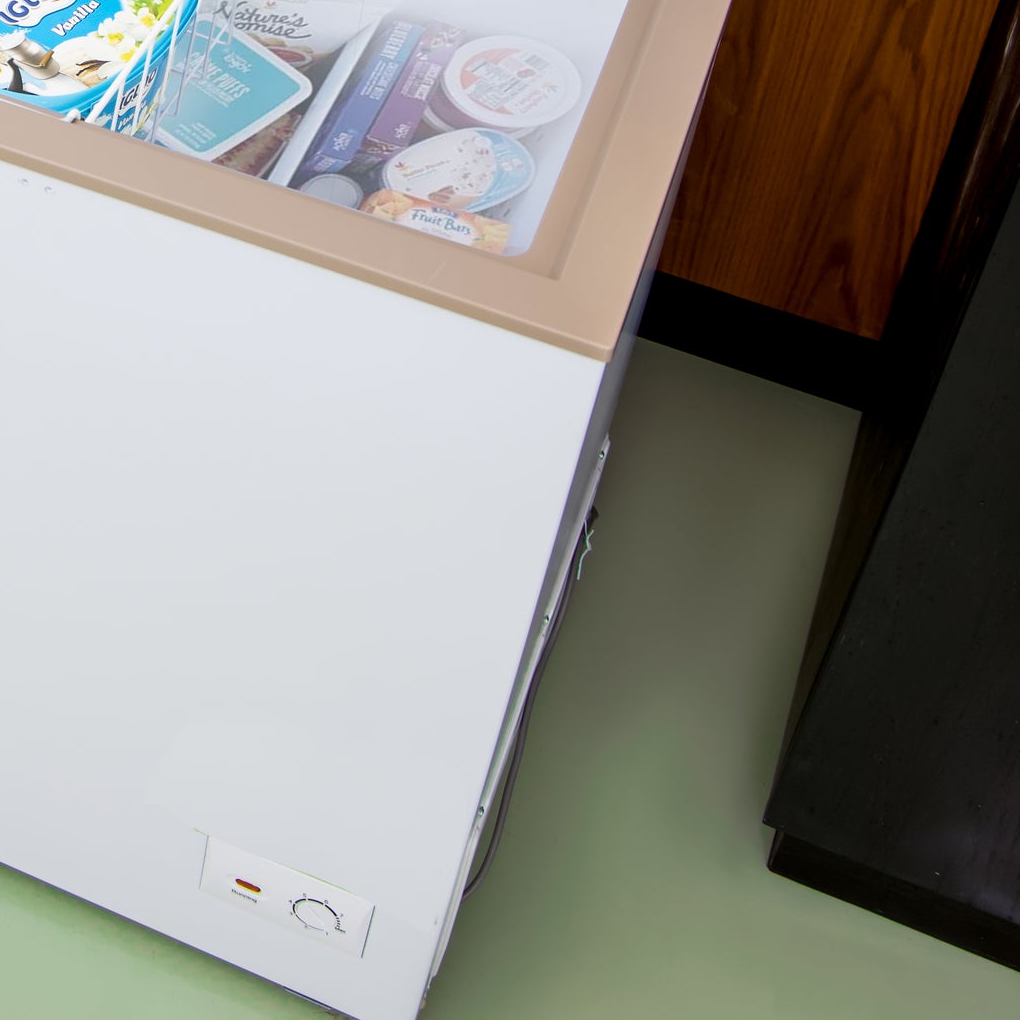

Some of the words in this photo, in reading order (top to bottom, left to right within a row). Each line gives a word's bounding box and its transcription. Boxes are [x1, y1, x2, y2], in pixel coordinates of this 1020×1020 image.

[51, 0, 100, 38] Vanilla
[410, 208, 444, 229] Fruit
[444, 213, 472, 236] Bars
